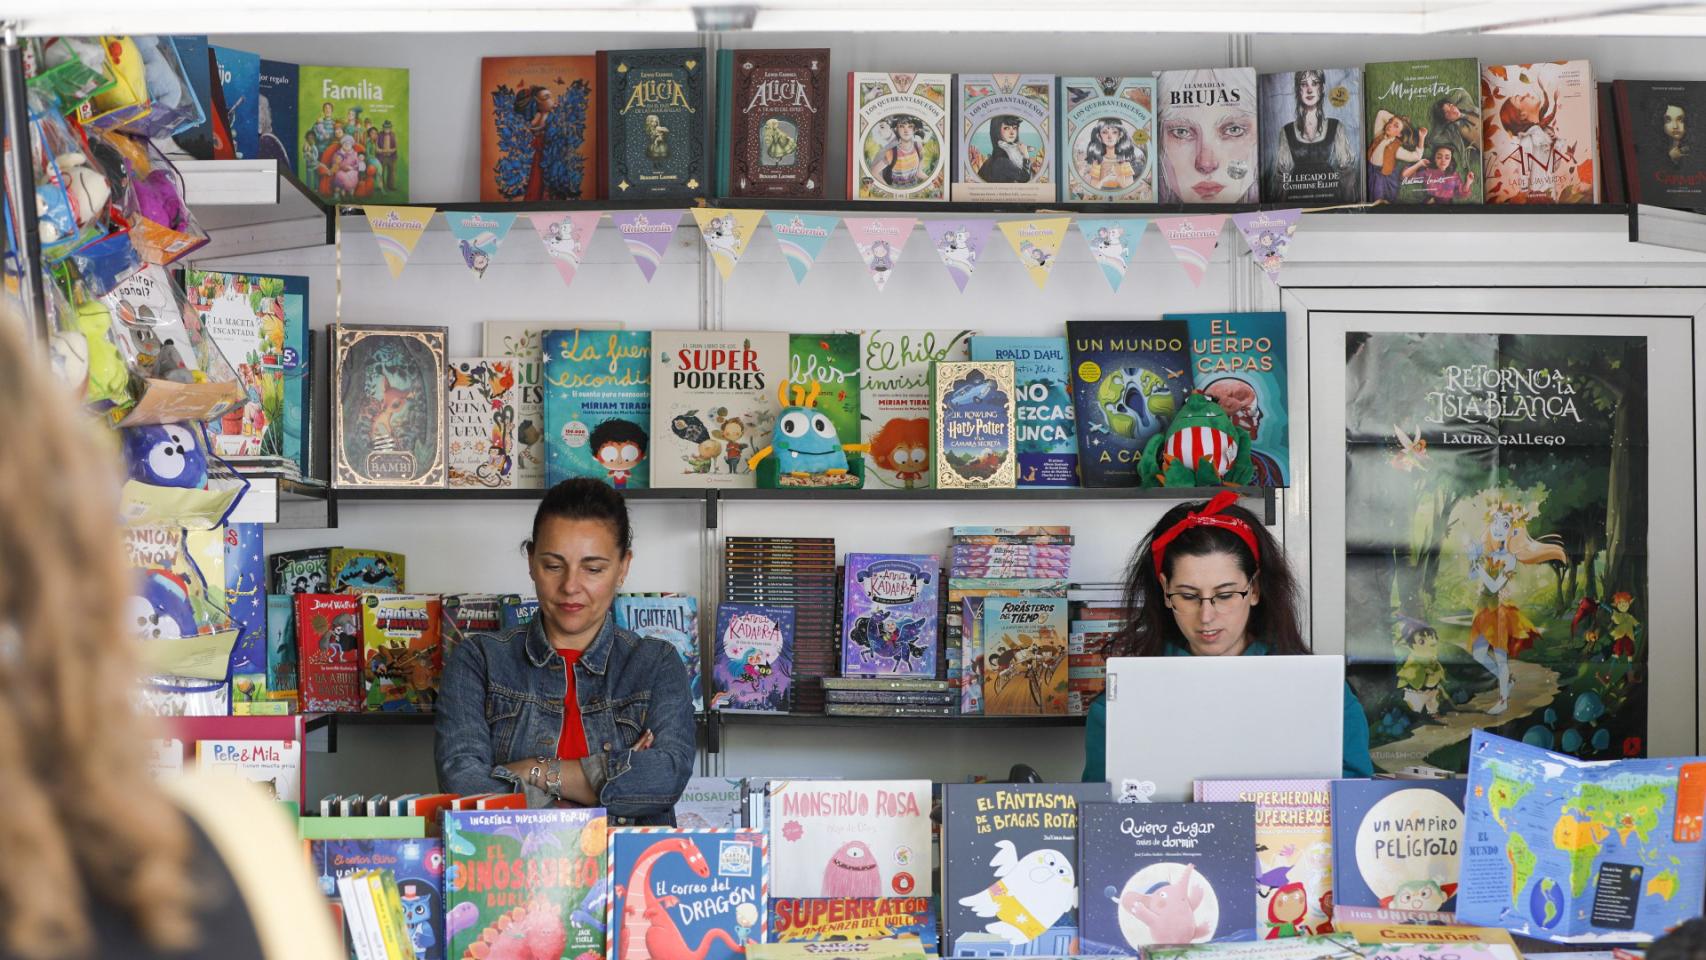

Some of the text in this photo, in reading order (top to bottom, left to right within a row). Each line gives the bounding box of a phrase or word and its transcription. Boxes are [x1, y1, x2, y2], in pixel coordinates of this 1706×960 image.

[322, 78, 384, 101] Familia
[619, 79, 696, 114] ALICIA
[743, 79, 818, 114] ALICIA
[1170, 88, 1241, 106] BRUJAS
[1378, 80, 1464, 101] Mujercitas
[865, 104, 879, 116] LOS
[969, 105, 982, 117] LOS
[1073, 109, 1086, 121] LOS
[1500, 143, 1571, 176] ANA
[1282, 171, 1340, 183] EL LEGADO DE
[620, 221, 673, 235] Unicornia
[776, 221, 827, 237] Unicornia
[213, 317, 255, 327] LA MACETA
[1210, 319, 1237, 335] EL
[212, 326, 255, 337] ENCANTADA
[561, 328, 602, 361] La
[866, 330, 948, 372] El hilo
[1076, 338, 1183, 351] UN MUNDO
[1192, 337, 1272, 355] UERPO
[678, 349, 761, 372] SUPER
[995, 349, 1064, 361] ROALD DAHL
[1196, 355, 1274, 373] CAPAS
[673, 370, 766, 391] PODERES
[1445, 364, 1552, 394] RETORNO
[457, 390, 475, 401] LA
[1016, 383, 1049, 403] NO
[581, 401, 618, 410] MÍRIAM
[1484, 390, 1585, 424] BLANCA
[468, 415, 482, 424] LA
[947, 418, 1006, 439] Harry Potter
[1442, 432, 1567, 446] LAURA GALLEGO
[1099, 450, 1112, 462] A
[370, 461, 413, 473] BAMBI
[1001, 602, 1055, 613] FORASTEROS
[625, 603, 689, 634] LIGHTFALL
[252, 745, 280, 762] Mila
[782, 790, 921, 818] MONSTRUO ROSA
[976, 790, 1077, 812] EL FANTASMA
[470, 811, 591, 826] INCREÍBLE DIVERSIÓN POP-UP
[1120, 817, 1168, 838] Quiero
[1161, 834, 1199, 848] dormir
[1478, 831, 1489, 843] EL
[1468, 845, 1499, 856] MUNDO
[453, 855, 599, 893] DINOSAURIO
[671, 877, 731, 895] correo del
[679, 885, 756, 926] DRAGÓN
[801, 917, 881, 936] AMENAZA DEL
[1378, 927, 1482, 942] Camuñas
